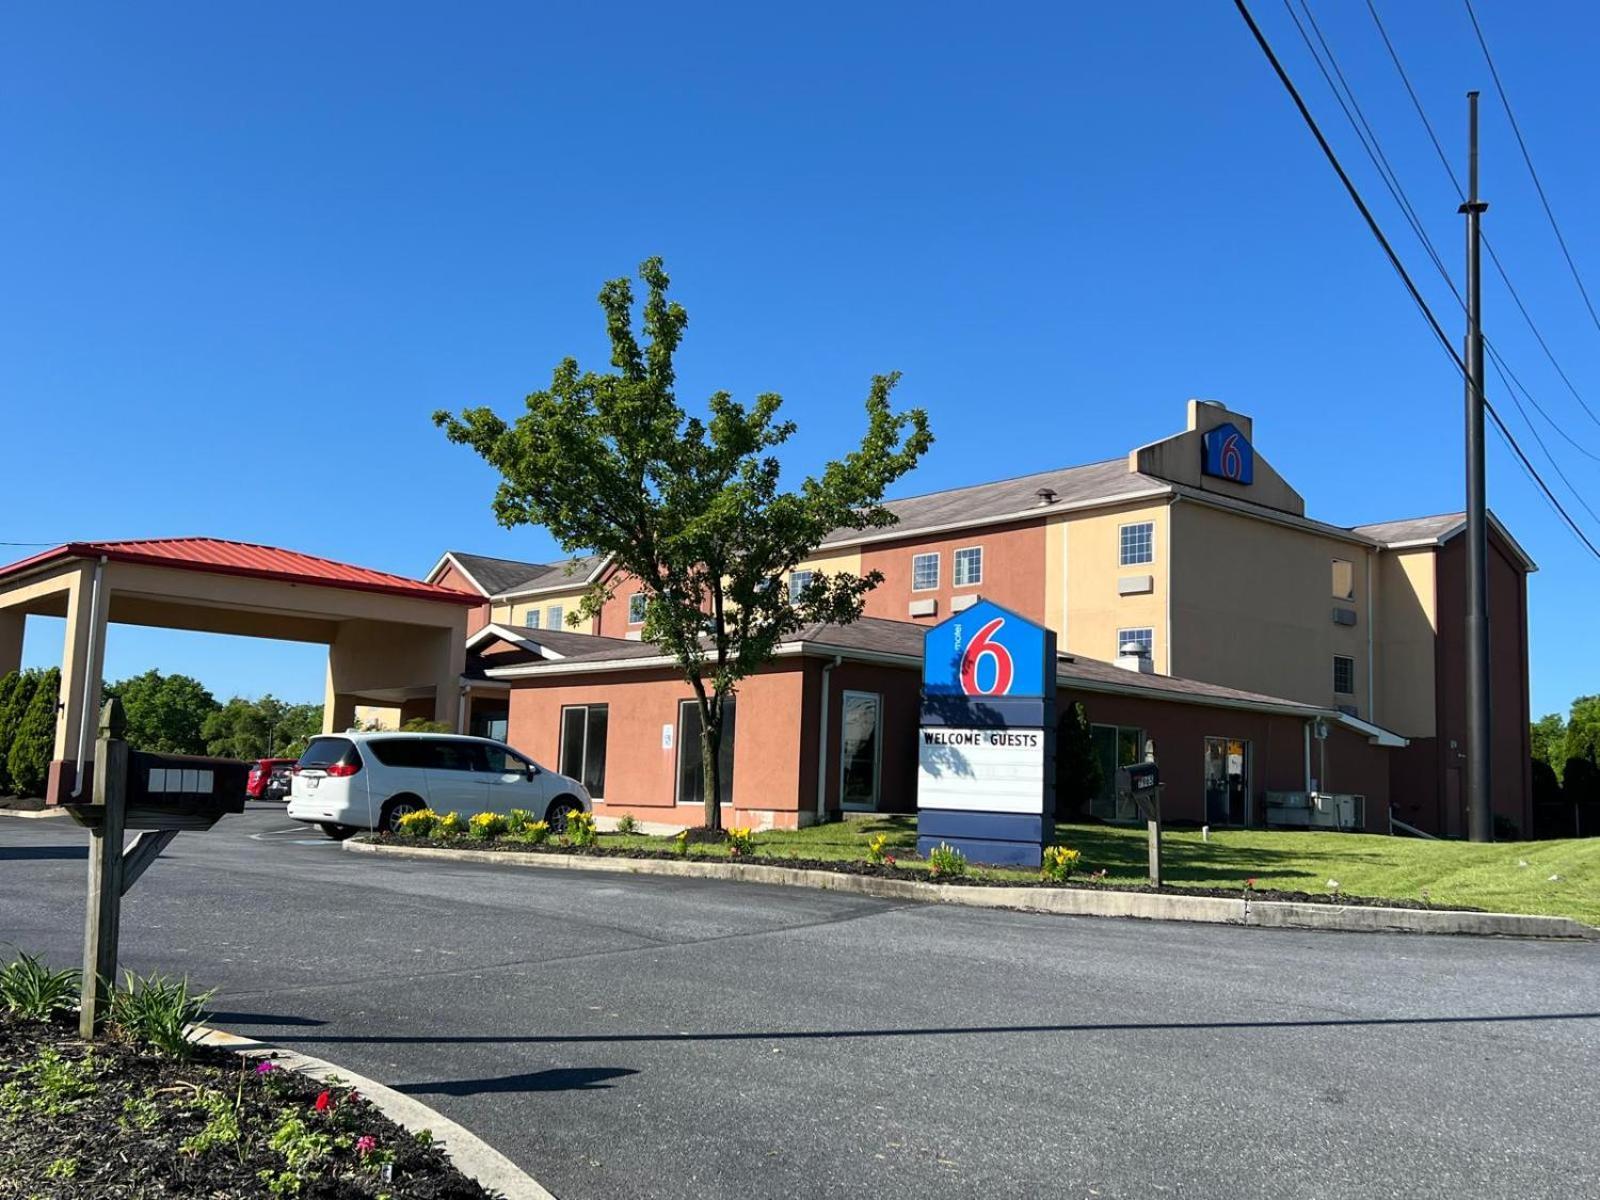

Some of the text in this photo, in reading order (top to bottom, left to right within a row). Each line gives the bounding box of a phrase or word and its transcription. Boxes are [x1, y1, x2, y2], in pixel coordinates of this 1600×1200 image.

[1220, 433, 1242, 480] 6
[954, 617, 1014, 695] motel 6
[924, 732, 1038, 747] WELCOME GUESTS
